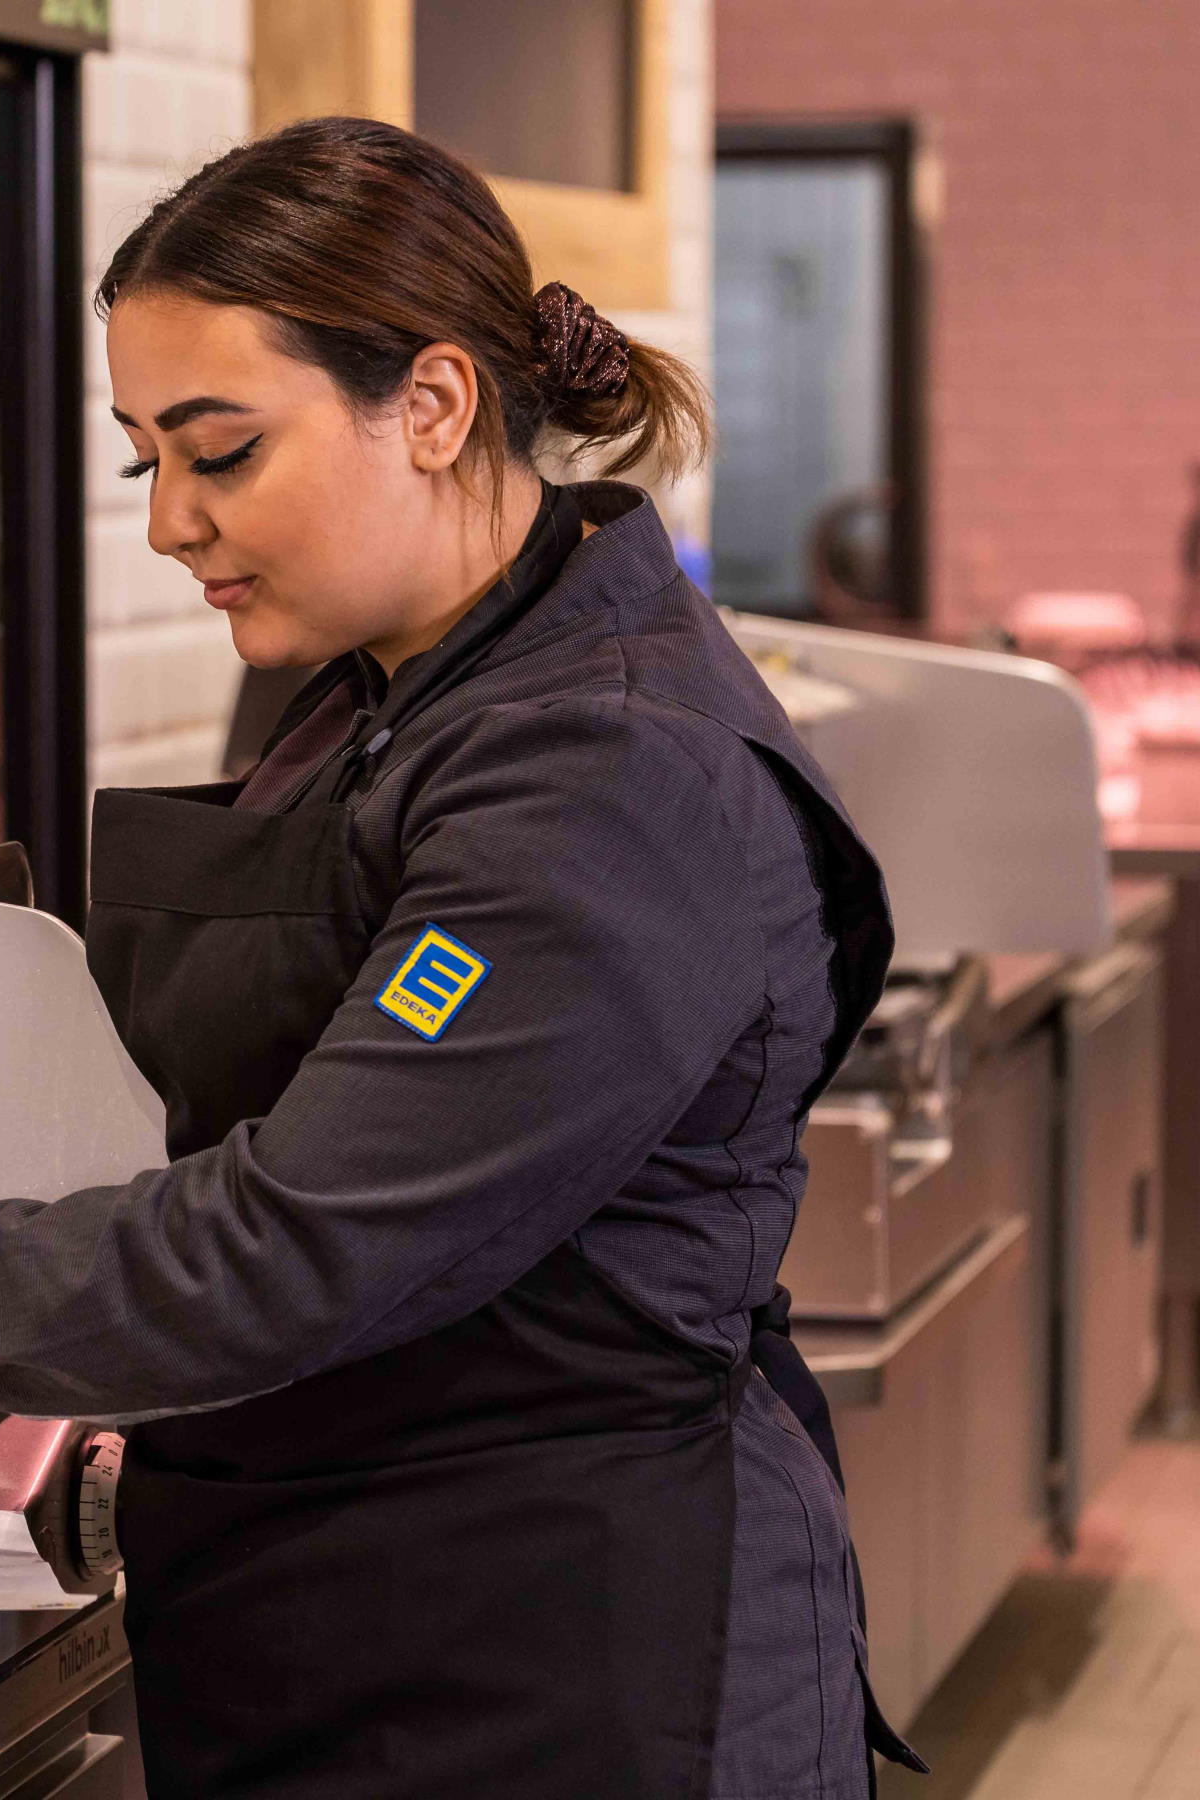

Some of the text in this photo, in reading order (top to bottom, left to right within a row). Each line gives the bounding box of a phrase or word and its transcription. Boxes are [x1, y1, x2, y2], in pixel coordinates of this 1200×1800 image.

[399, 942, 474, 1011] E
[390, 990, 437, 1025] EDEKA
[102, 1465, 113, 1476] 24
[97, 1498, 109, 1510] 22
[98, 1527, 109, 1538] 20
